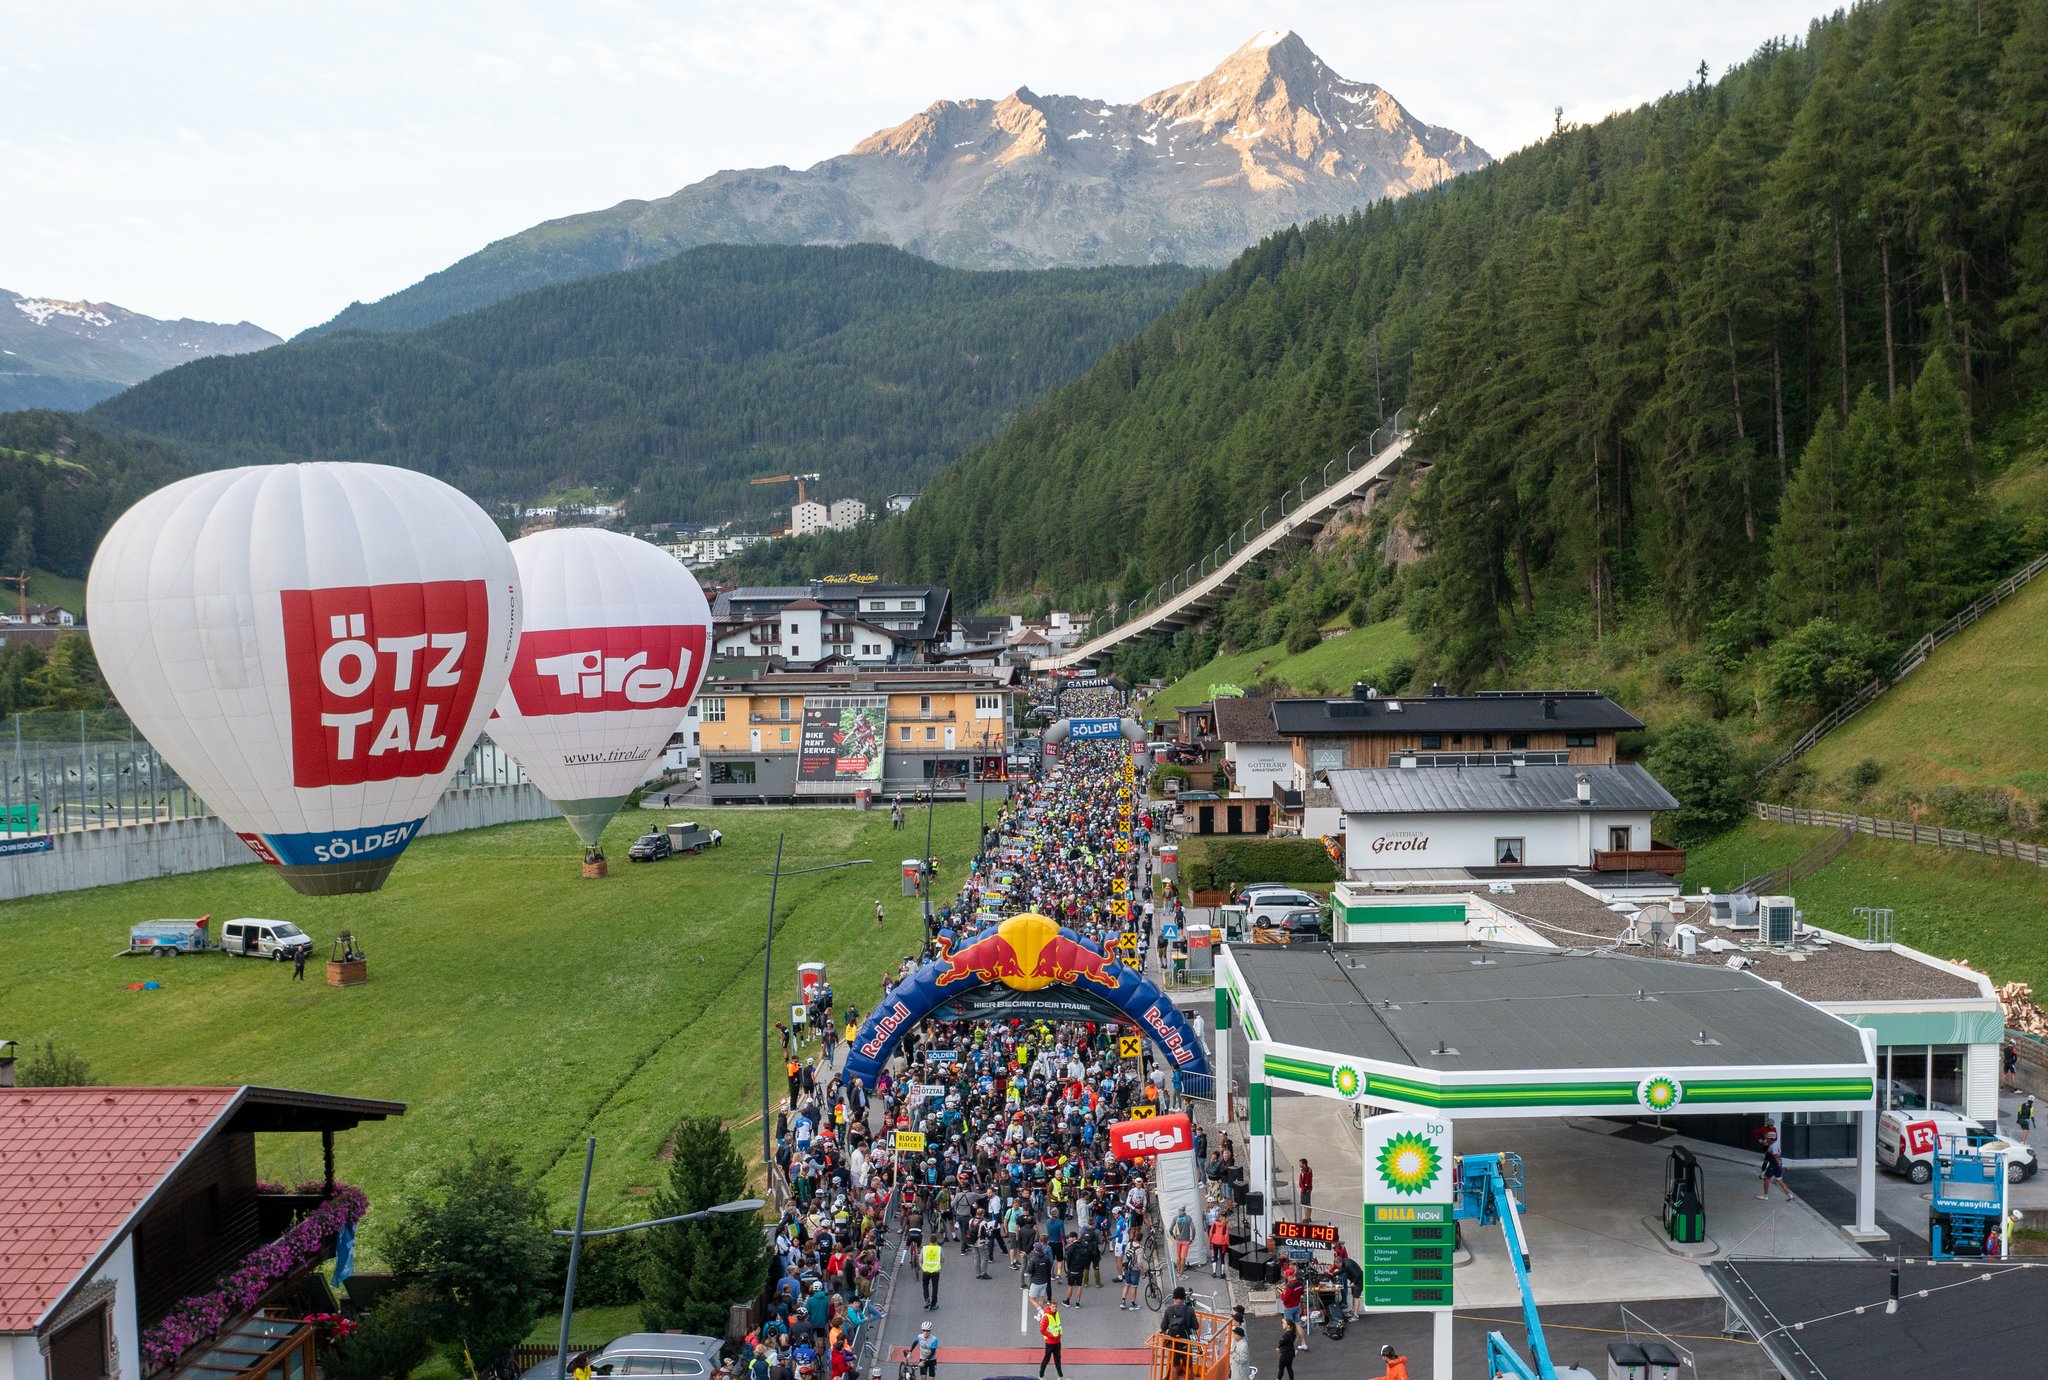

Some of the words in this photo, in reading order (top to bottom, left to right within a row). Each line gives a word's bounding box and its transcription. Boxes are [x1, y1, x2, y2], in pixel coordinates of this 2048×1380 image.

[823, 575, 848, 583] Hotel
[849, 573, 879, 584] Regina
[320, 613, 467, 698] ÖTZ
[535, 647, 692, 703] Tirol
[1067, 679, 1109, 688] GARMIN
[321, 703, 447, 760] TAL
[1072, 722, 1118, 736] SÖLDEN
[563, 746, 650, 764] www.tirol.at
[314, 823, 414, 862] SÖLDEN
[1372, 837, 1429, 854] Gerold
[861, 1025, 890, 1059] Red
[880, 1001, 911, 1033] Bull
[1144, 1005, 1176, 1039] Red
[1165, 1032, 1194, 1065] Bull
[928, 1052, 956, 1060] SÖLDEN
[922, 1087, 943, 1095] ÖTZTAL
[1427, 1122, 1444, 1136] bp
[888, 1134, 895, 1147] A
[899, 1134, 917, 1142] BLOCK
[1122, 1126, 1182, 1150] Tirol
[1937, 1200, 2000, 1209] www.easylift.at
[1378, 1208, 1415, 1220] BILLA
[1417, 1212, 1440, 1220] NOW
[1279, 1223, 1334, 1240] 06:11:48
[1285, 1239, 1326, 1249] GARMIN
